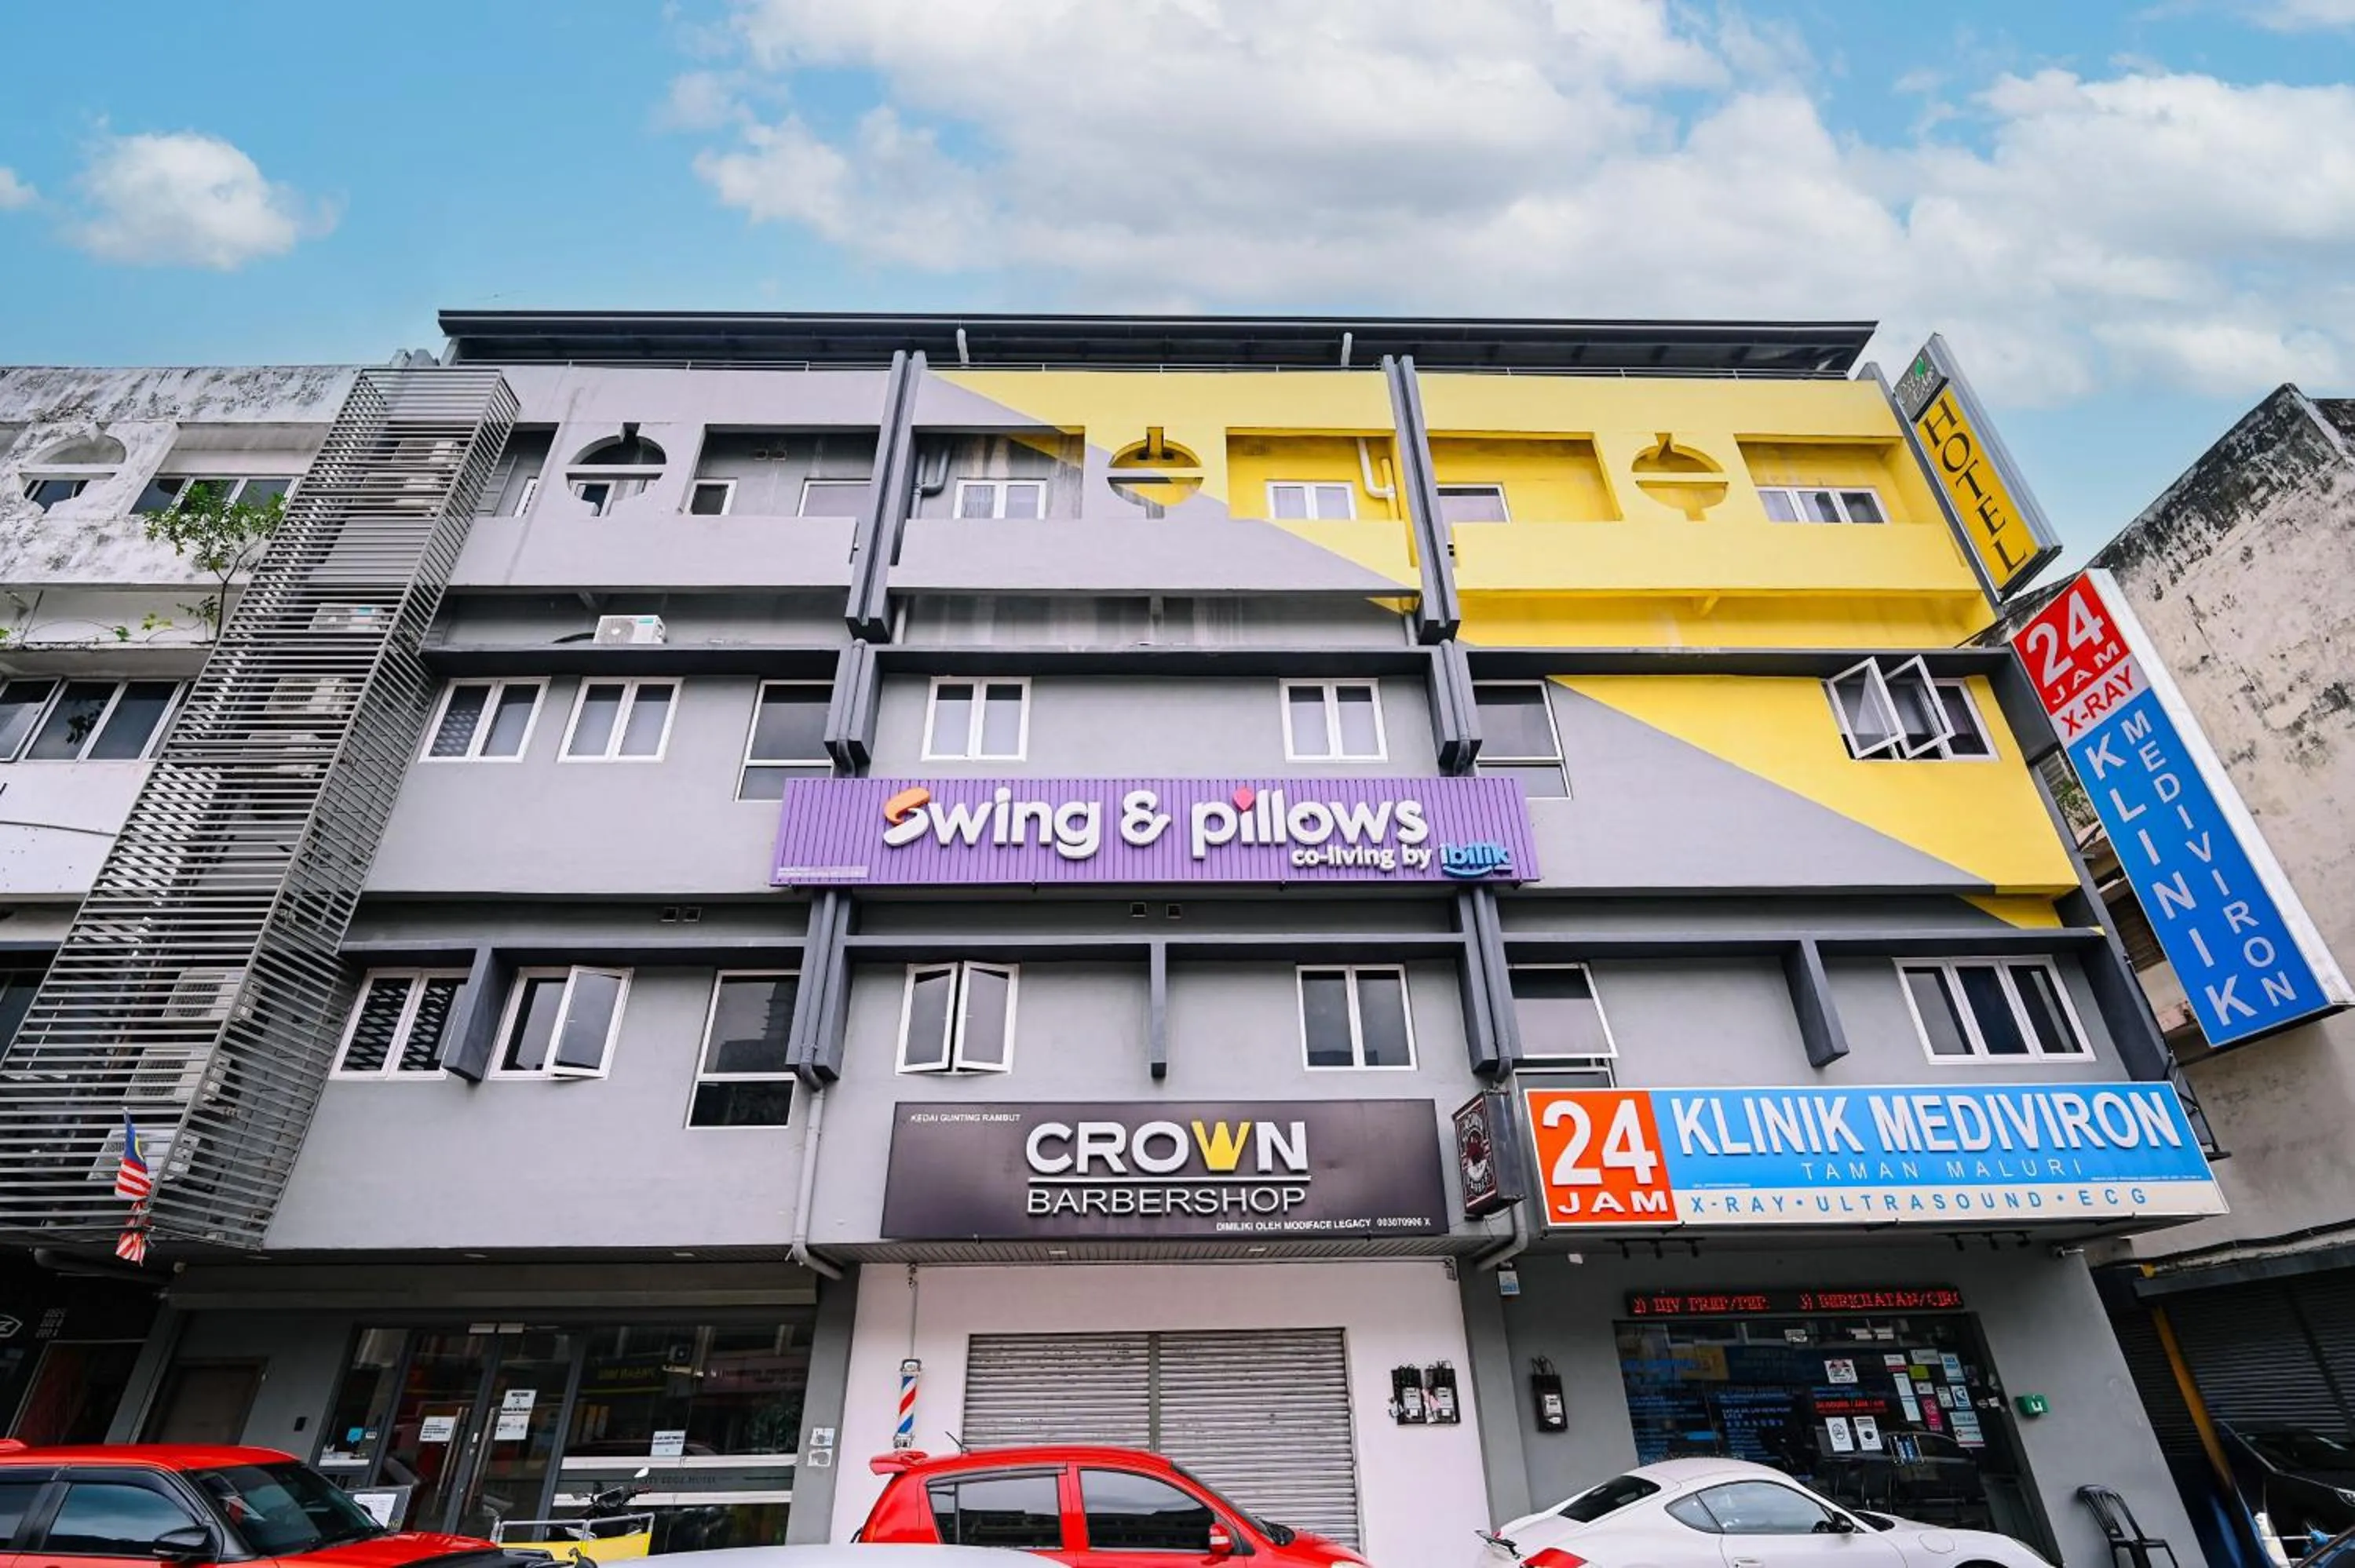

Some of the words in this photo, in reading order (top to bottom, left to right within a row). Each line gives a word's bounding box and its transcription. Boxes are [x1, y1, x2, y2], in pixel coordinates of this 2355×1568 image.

[1924, 398, 2027, 574] HOTEL
[2026, 589, 2105, 688] 24
[2052, 640, 2120, 705] JAM
[2061, 665, 2134, 738] X-RAY
[883, 786, 1101, 860] Swing
[1120, 789, 1172, 846] &
[1191, 786, 1429, 860] pillows
[1291, 844, 1396, 872] co-living
[1401, 844, 1433, 870] by
[2084, 731, 2258, 1026] KLINIK
[2120, 709, 2297, 1007] MEDIVIRON
[911, 1114, 938, 1122] KEDAI
[940, 1114, 980, 1122] GUNTING
[982, 1114, 1020, 1122] RAMBUT
[1026, 1121, 1309, 1175] CROWN
[1543, 1099, 1658, 1187] 24
[1670, 1096, 1865, 1156] KLINIK
[1868, 1092, 2182, 1152] MEDIVIRON
[1027, 1186, 1307, 1216] BARBERSHOP
[1691, 1195, 1783, 1213] X-RAY
[1816, 1191, 2042, 1212] ULTRASOUND
[2078, 1187, 2145, 1206] ECG
[1802, 1161, 1919, 1180] TAMAN
[1947, 1158, 2082, 1179] MALURI
[1216, 1222, 1254, 1231] DIMILIKI
[1256, 1221, 1282, 1231] OLEH
[1283, 1220, 1332, 1231] MODIFACE
[1334, 1218, 1371, 1229] LEGACY
[1557, 1191, 1669, 1215] JAM
